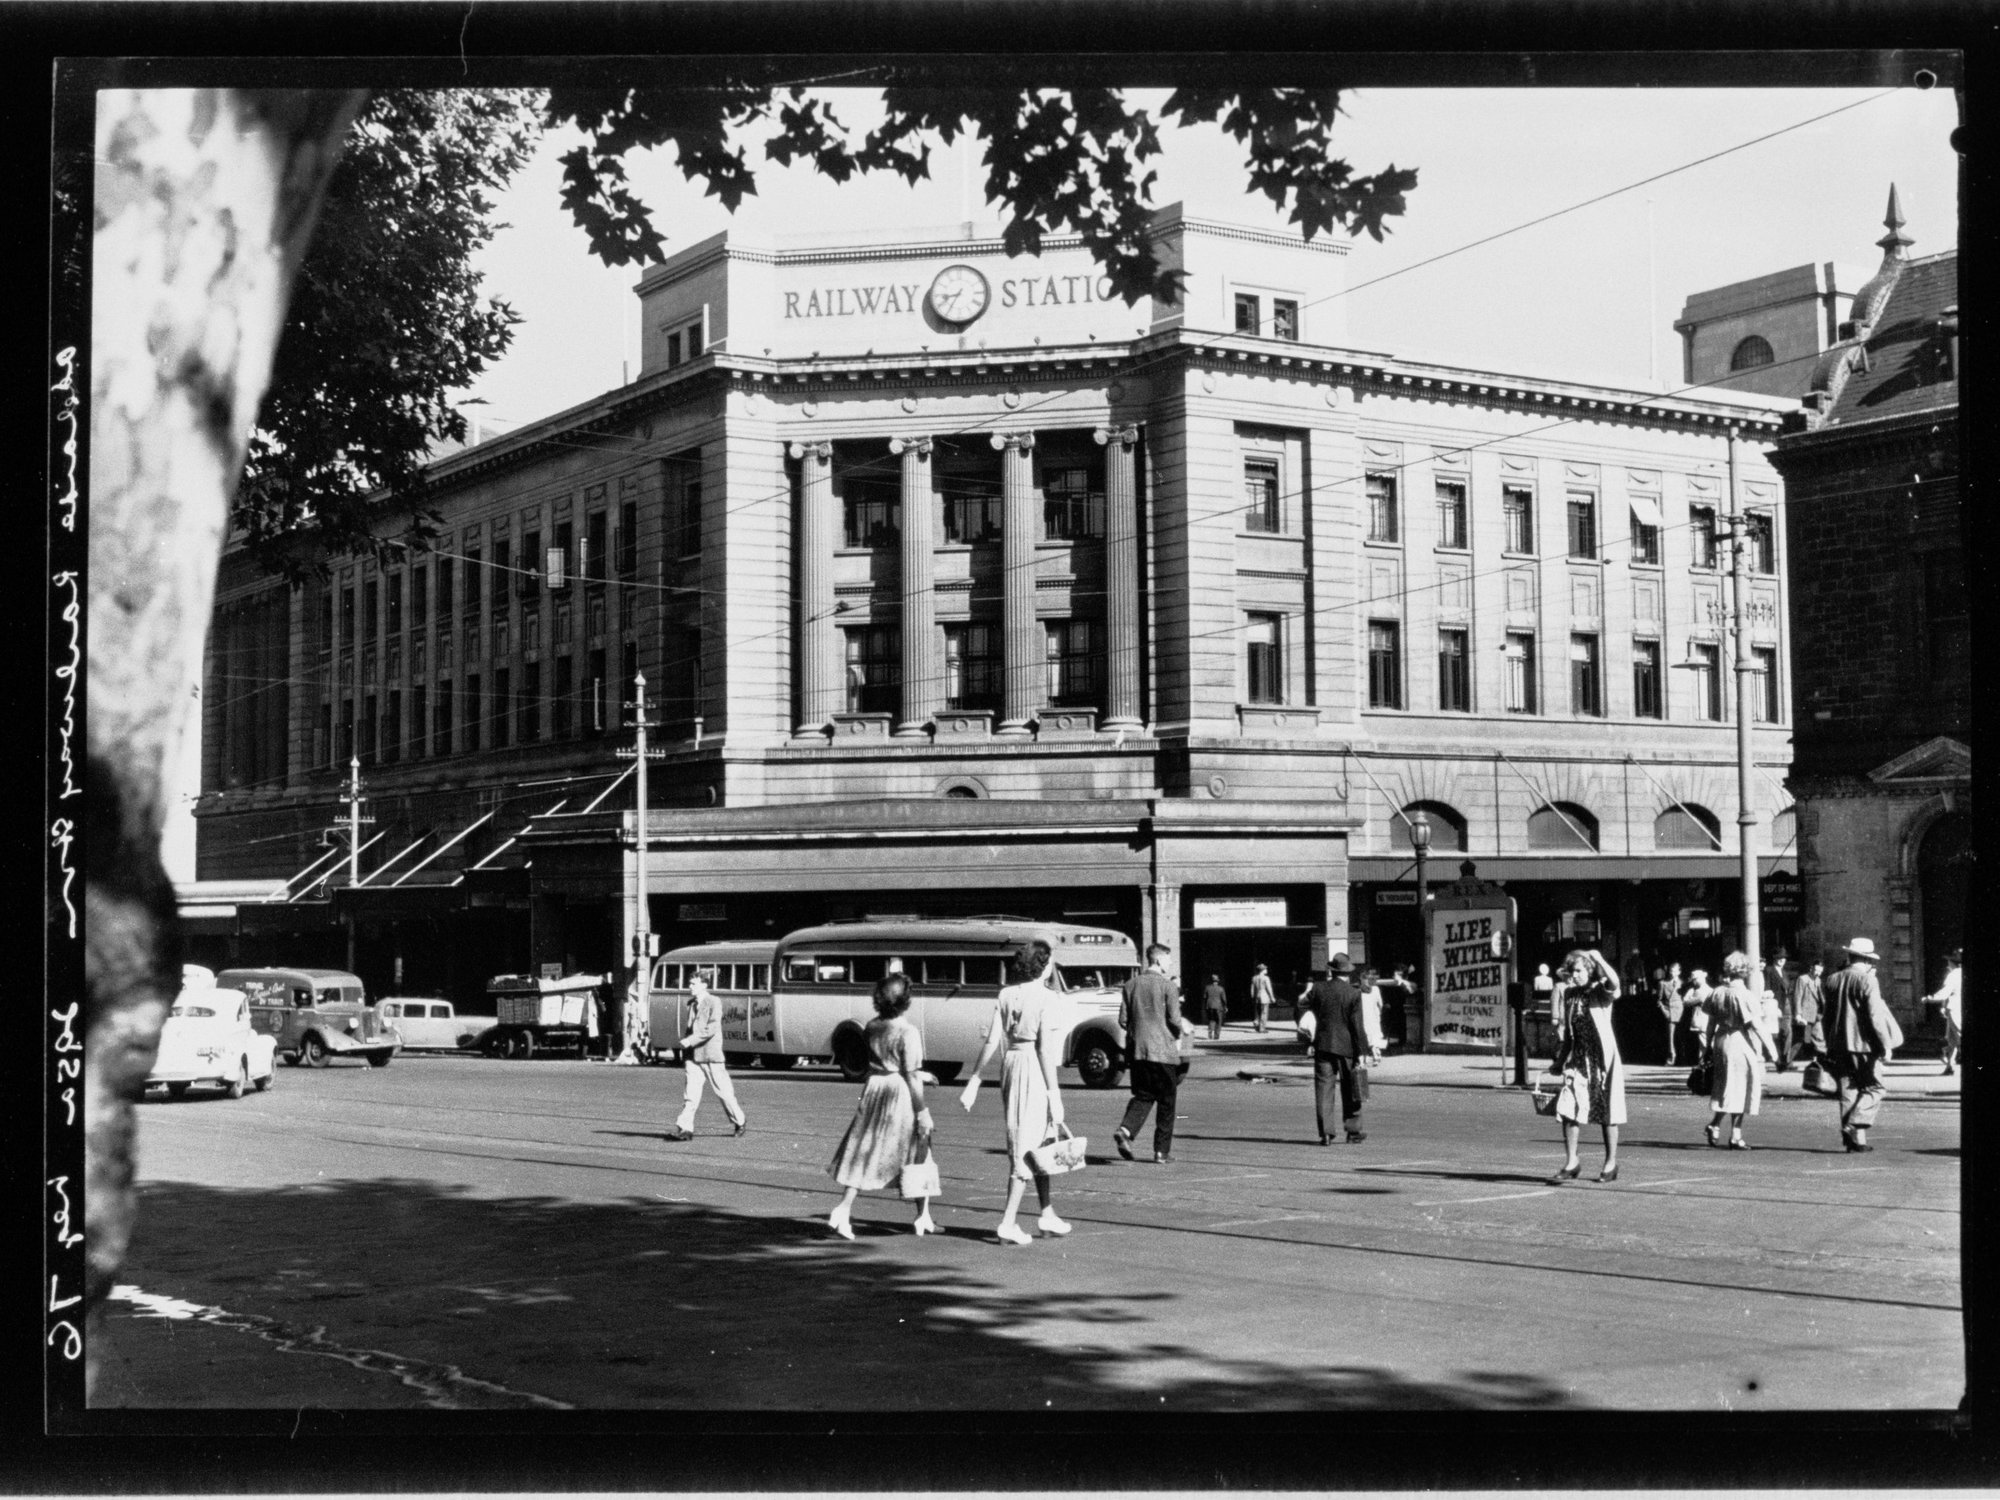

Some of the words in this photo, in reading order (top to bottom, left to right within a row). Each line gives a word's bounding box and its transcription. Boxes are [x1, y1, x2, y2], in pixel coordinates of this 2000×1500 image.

[784, 283, 920, 319] RAILWAY
[1002, 274, 1113, 308] STATIO
[1445, 917, 1492, 944] LIFE
[1443, 942, 1493, 969] WITH
[1436, 965, 1501, 994] FATHER
[1462, 1006, 1495, 1017] DUNNE
[722, 1031, 748, 1041] LENELG
[1433, 1023, 1459, 1036] SHORT
[1460, 1025, 1502, 1038] SUBJECTS
